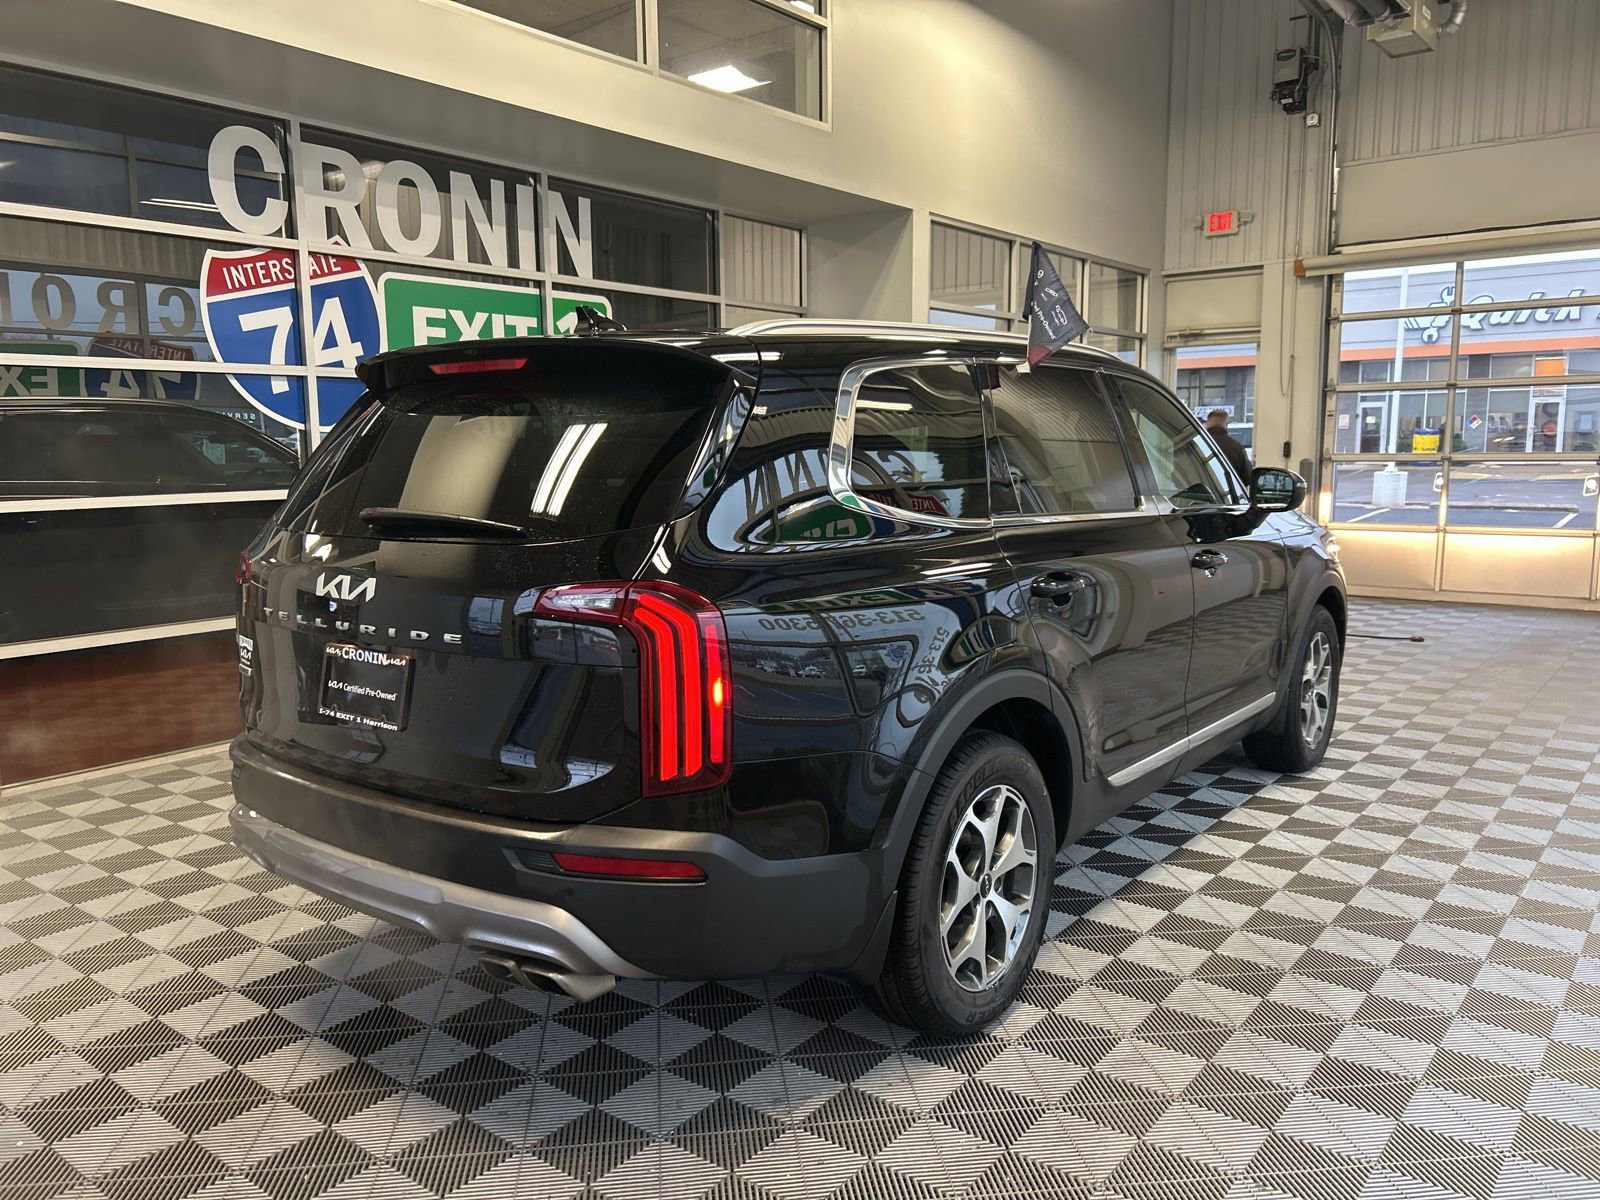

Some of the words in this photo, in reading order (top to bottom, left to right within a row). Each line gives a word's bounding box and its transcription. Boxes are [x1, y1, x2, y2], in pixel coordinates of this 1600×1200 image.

[207, 125, 594, 279] CRONIN
[1209, 212, 1233, 232] EXIT
[222, 255, 342, 290] INTERSATE
[238, 297, 365, 395] 74
[315, 572, 377, 602] KIA
[263, 606, 463, 645] TELLURIDE
[341, 647, 388, 666] CRONIN
[343, 683, 365, 695] Certified
[365, 687, 397, 701] Pre-Owned
[319, 707, 335, 717] I-74
[335, 712, 355, 721] EXIT
[363, 718, 398, 731] Harrison
